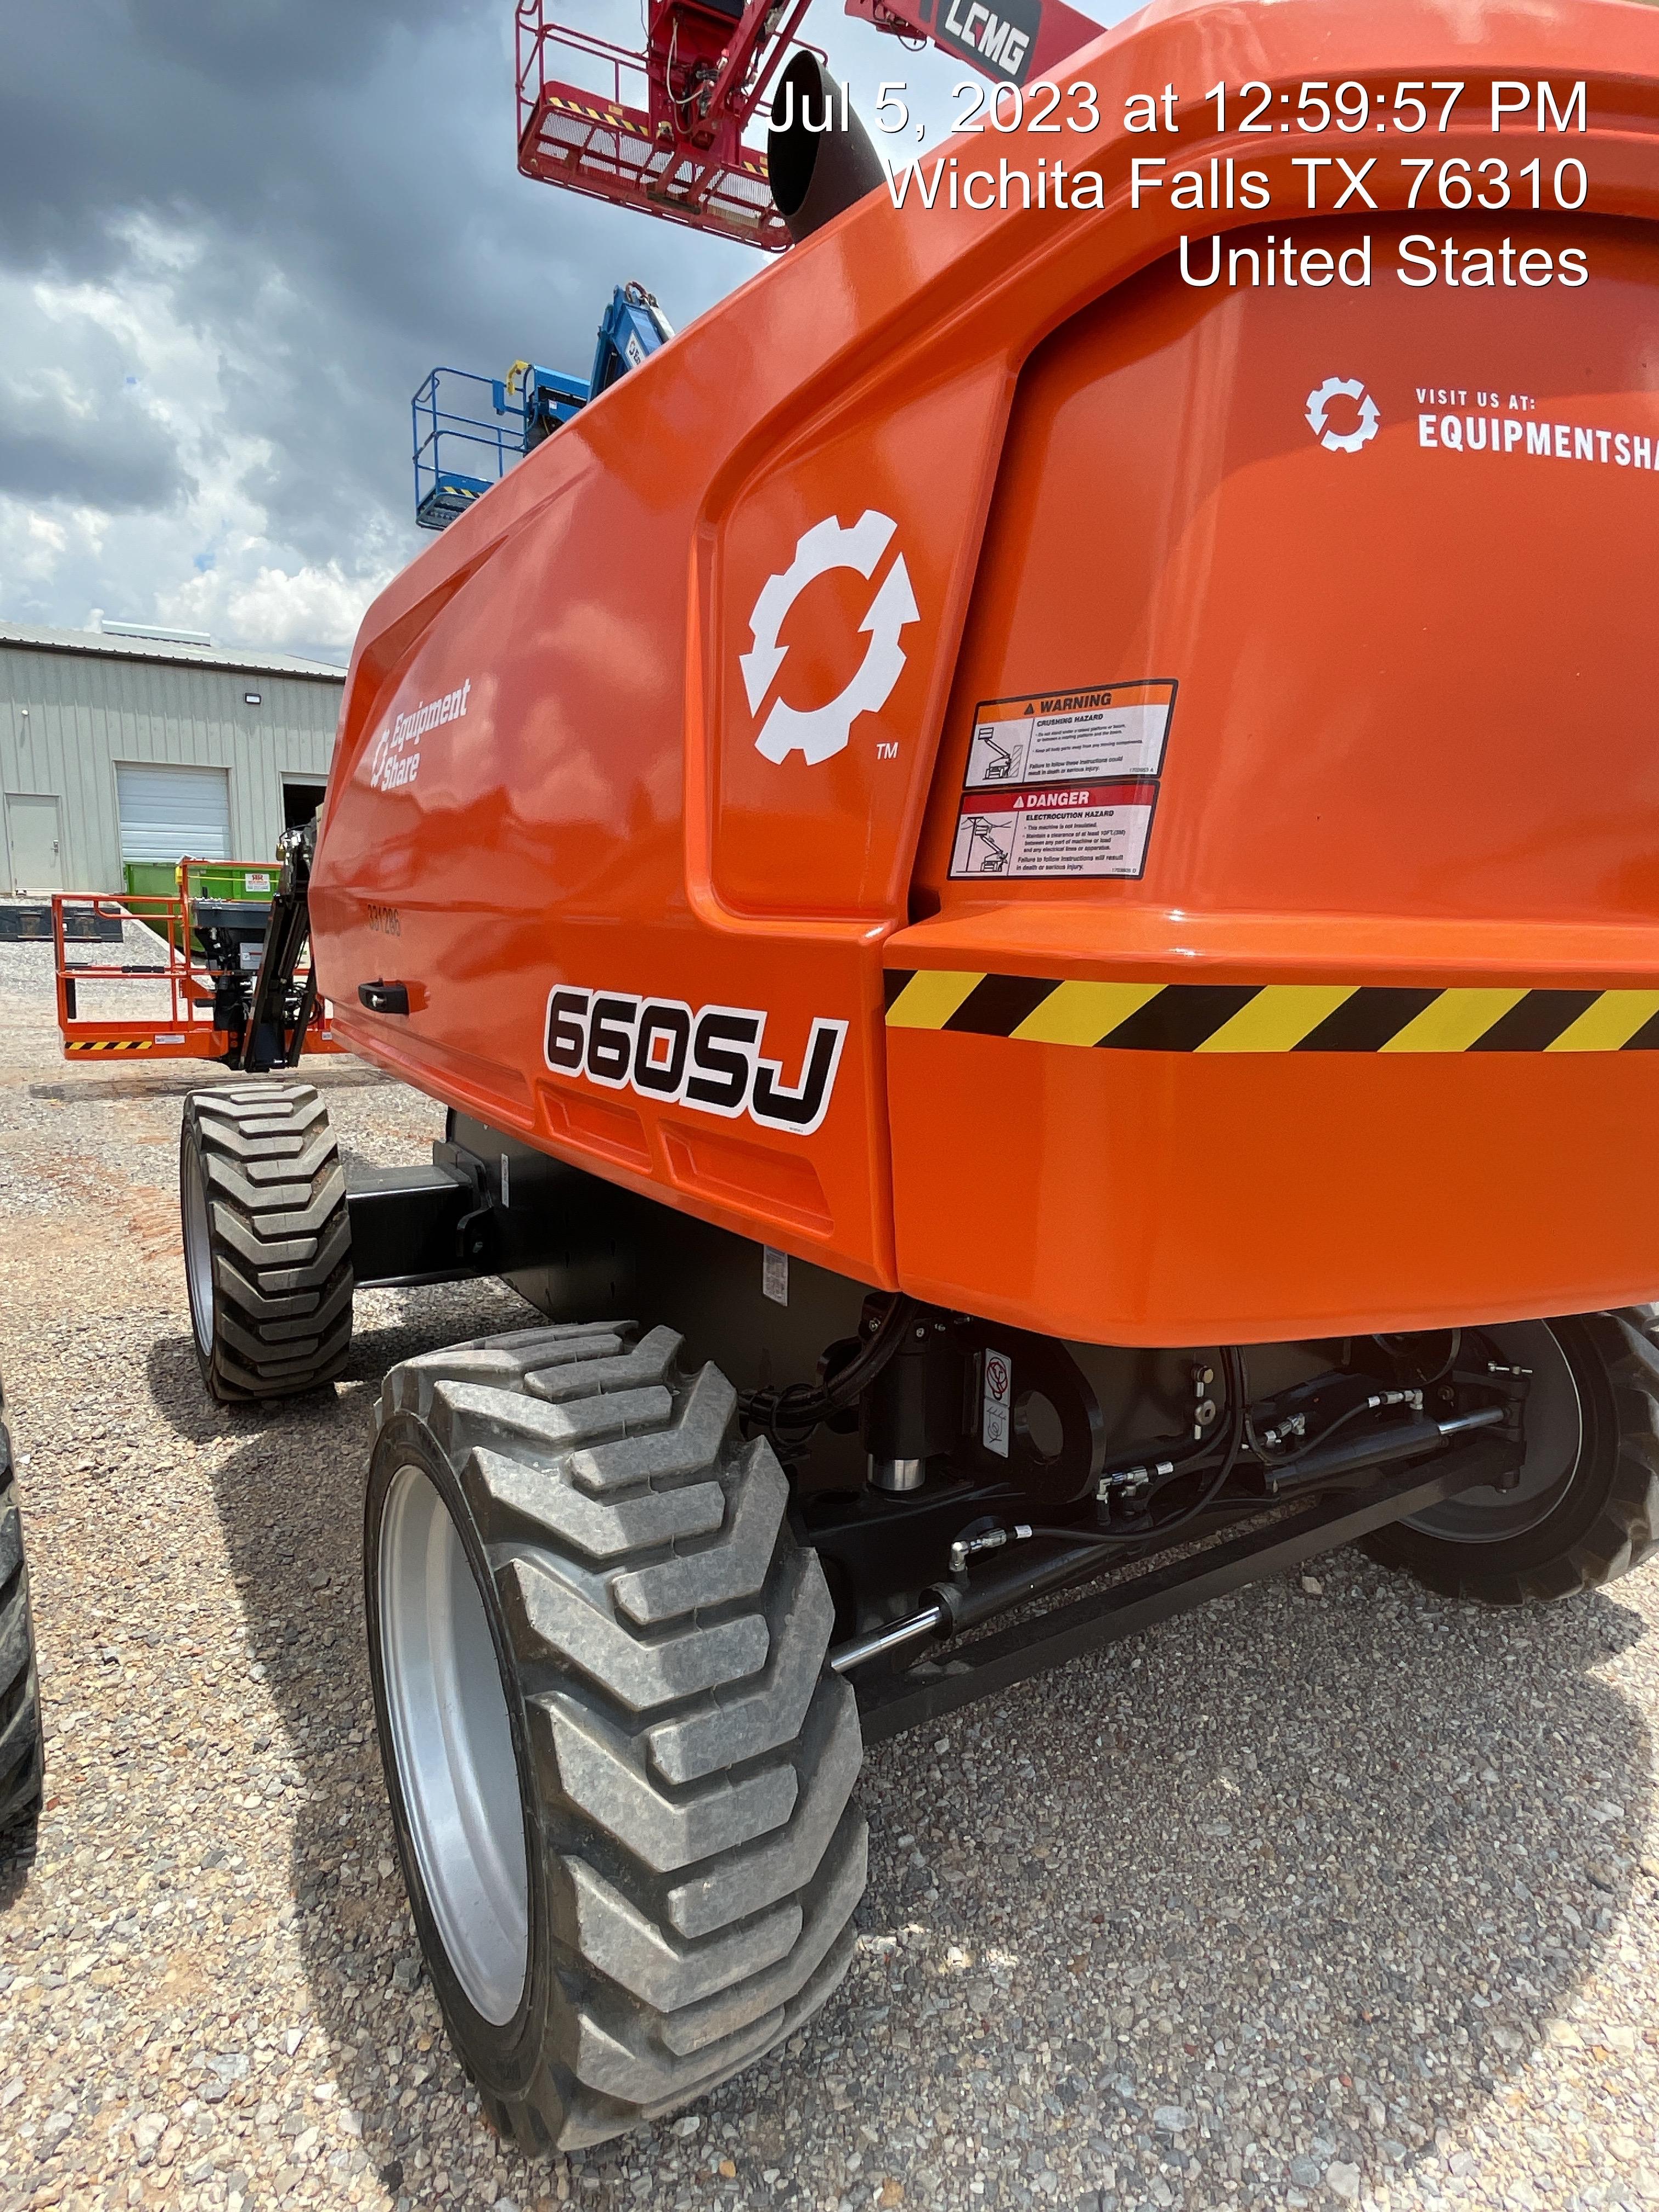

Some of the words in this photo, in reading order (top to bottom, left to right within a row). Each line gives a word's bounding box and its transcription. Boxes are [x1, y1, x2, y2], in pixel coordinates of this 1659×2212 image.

[945, 0, 1030, 75] LCMG
[1415, 388, 1467, 406] VISIT
[1477, 391, 1499, 408] US
[1509, 394, 1536, 411] AT:
[1041, 693, 1112, 713] WARNING
[390, 678, 471, 752] Equipment
[1037, 718, 1072, 727] CRUSHING
[1074, 714, 1103, 723] HAZARD
[877, 742, 898, 760] TM
[381, 752, 421, 792] Share
[1026, 791, 1089, 808] DANGER
[1026, 812, 1083, 821] ELECTROCUTION
[547, 987, 842, 1129] 660SJ
